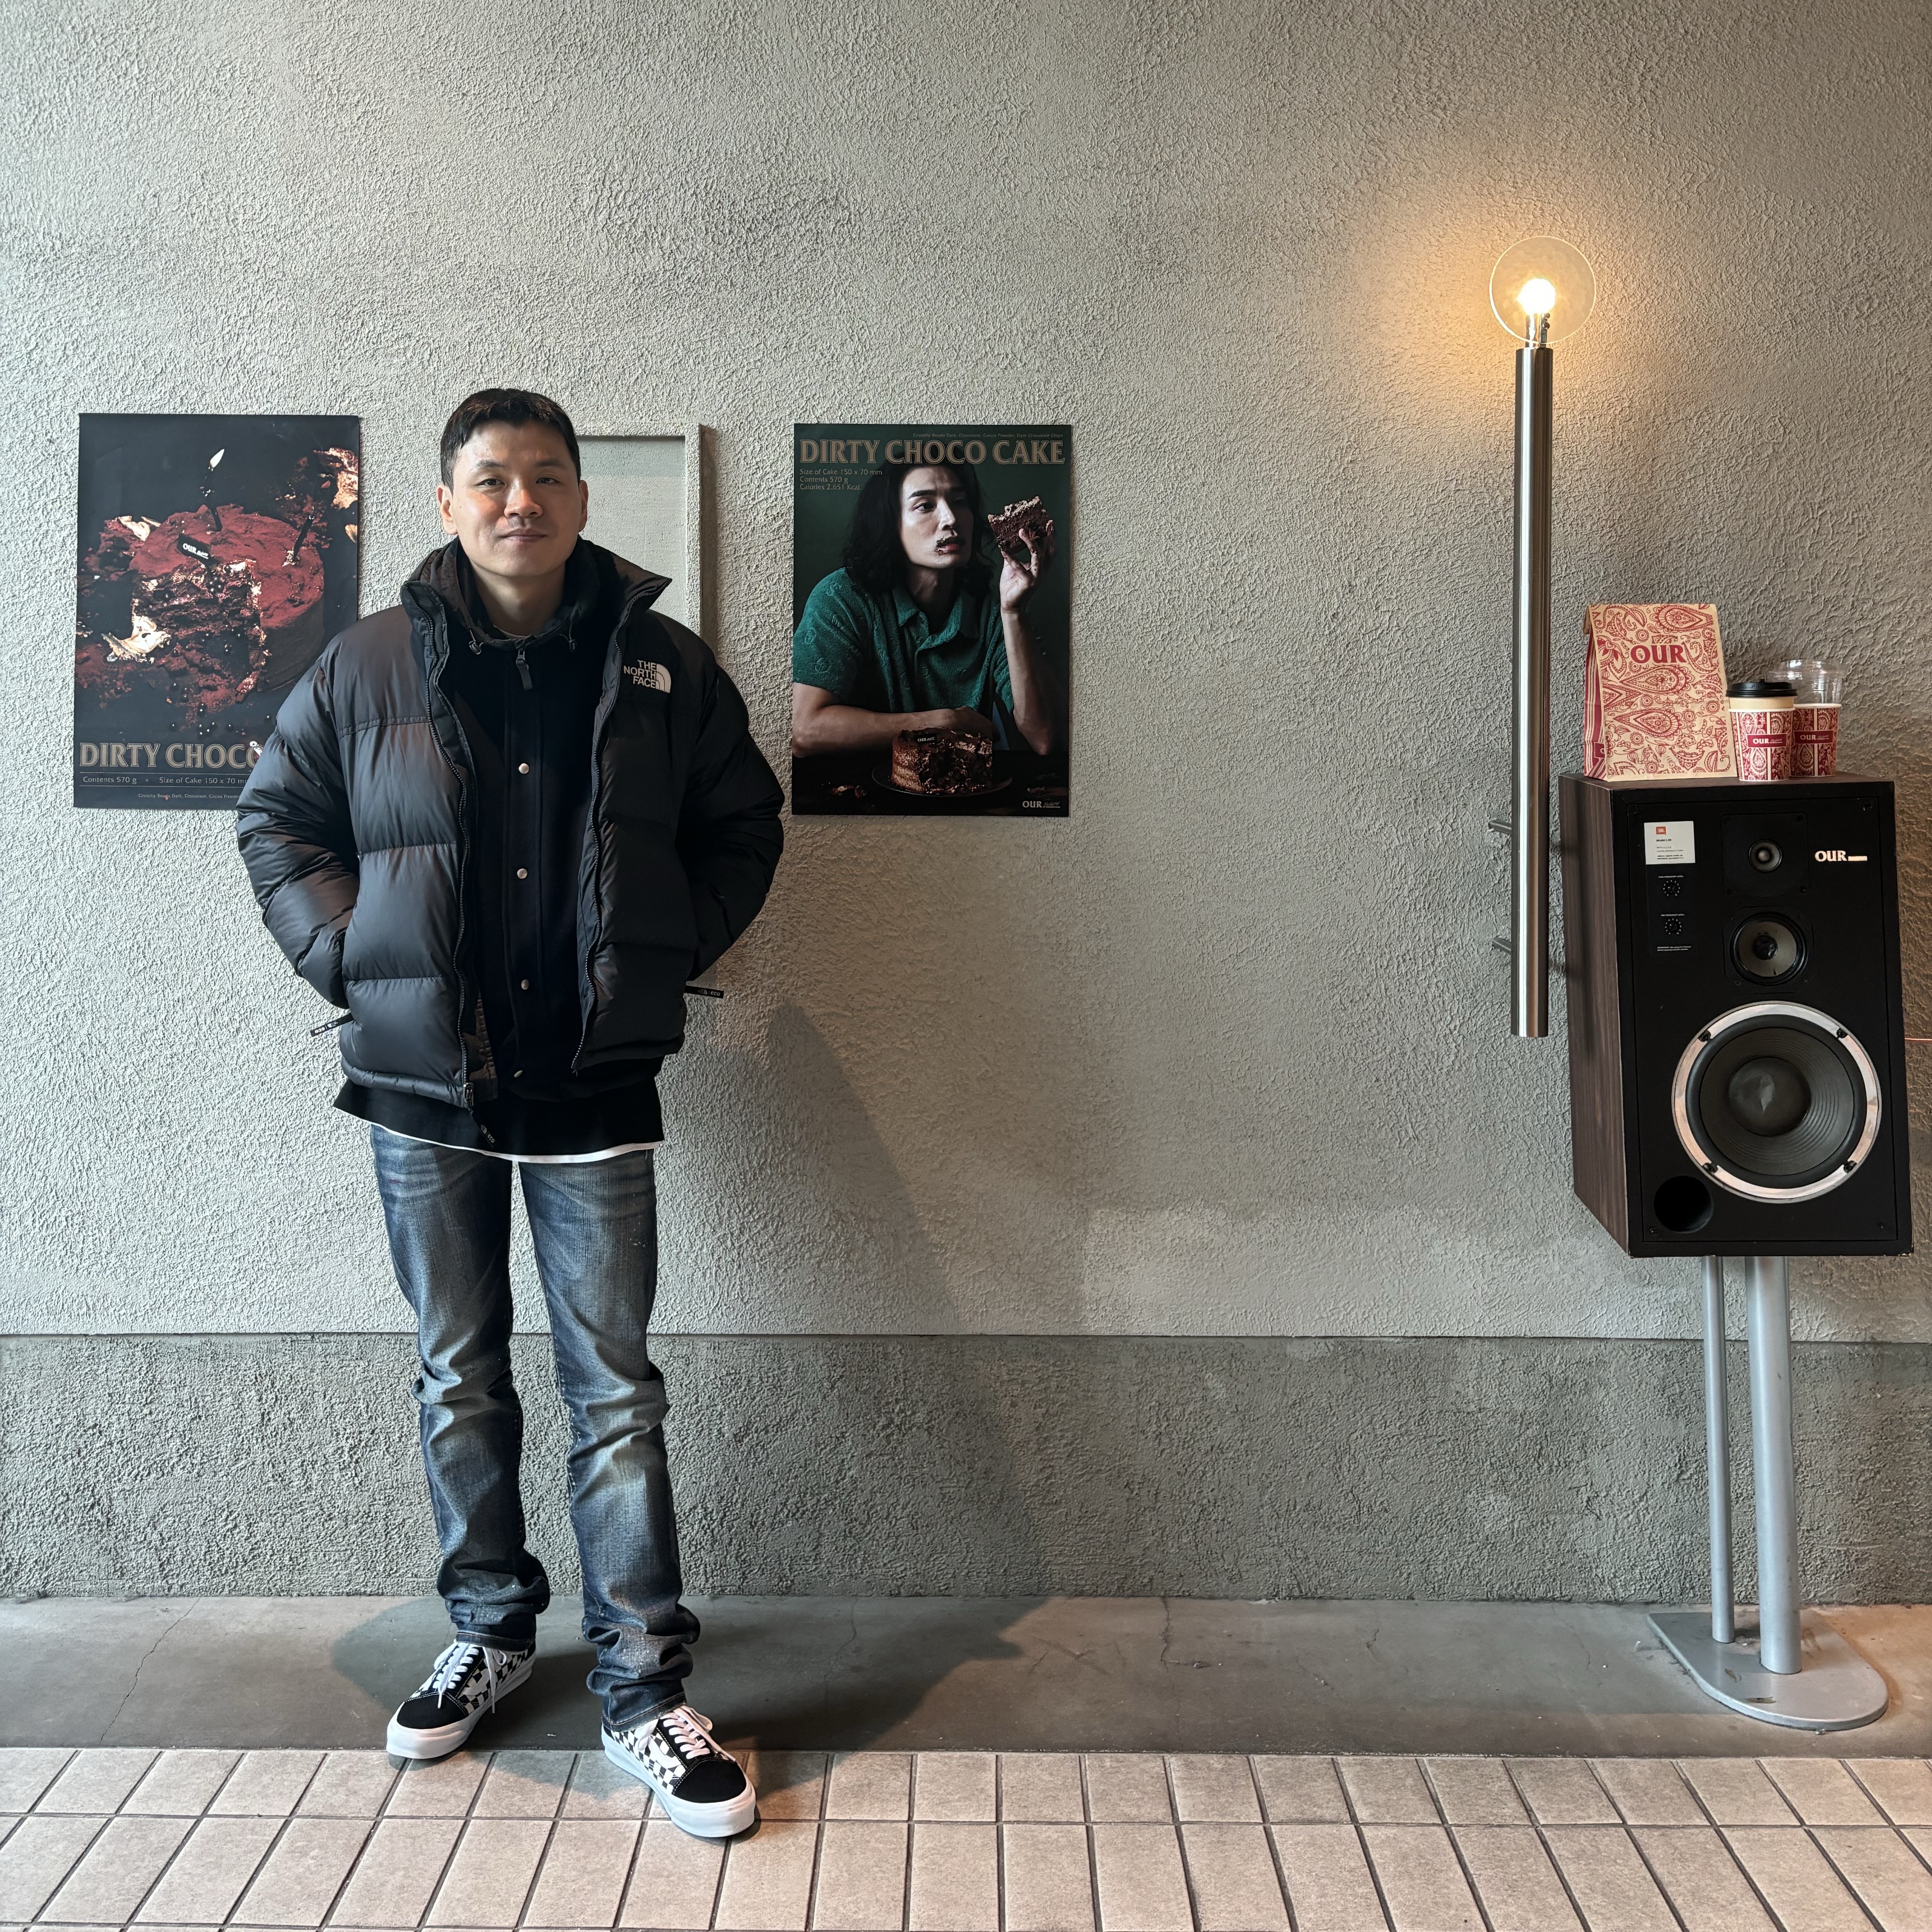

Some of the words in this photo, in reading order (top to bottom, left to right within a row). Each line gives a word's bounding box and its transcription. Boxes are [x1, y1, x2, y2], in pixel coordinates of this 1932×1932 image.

[800, 439, 880, 464] DIRTY
[885, 439, 987, 464] CHOCO
[992, 440, 1065, 464] CAKE
[183, 543, 197, 554] OUR
[1630, 645, 1687, 663] OUR
[637, 659, 656, 671] THE
[623, 665, 656, 680] NORTH
[633, 676, 656, 688] FACE
[80, 743, 161, 767] DIRTY
[1815, 850, 1848, 862] OUR
